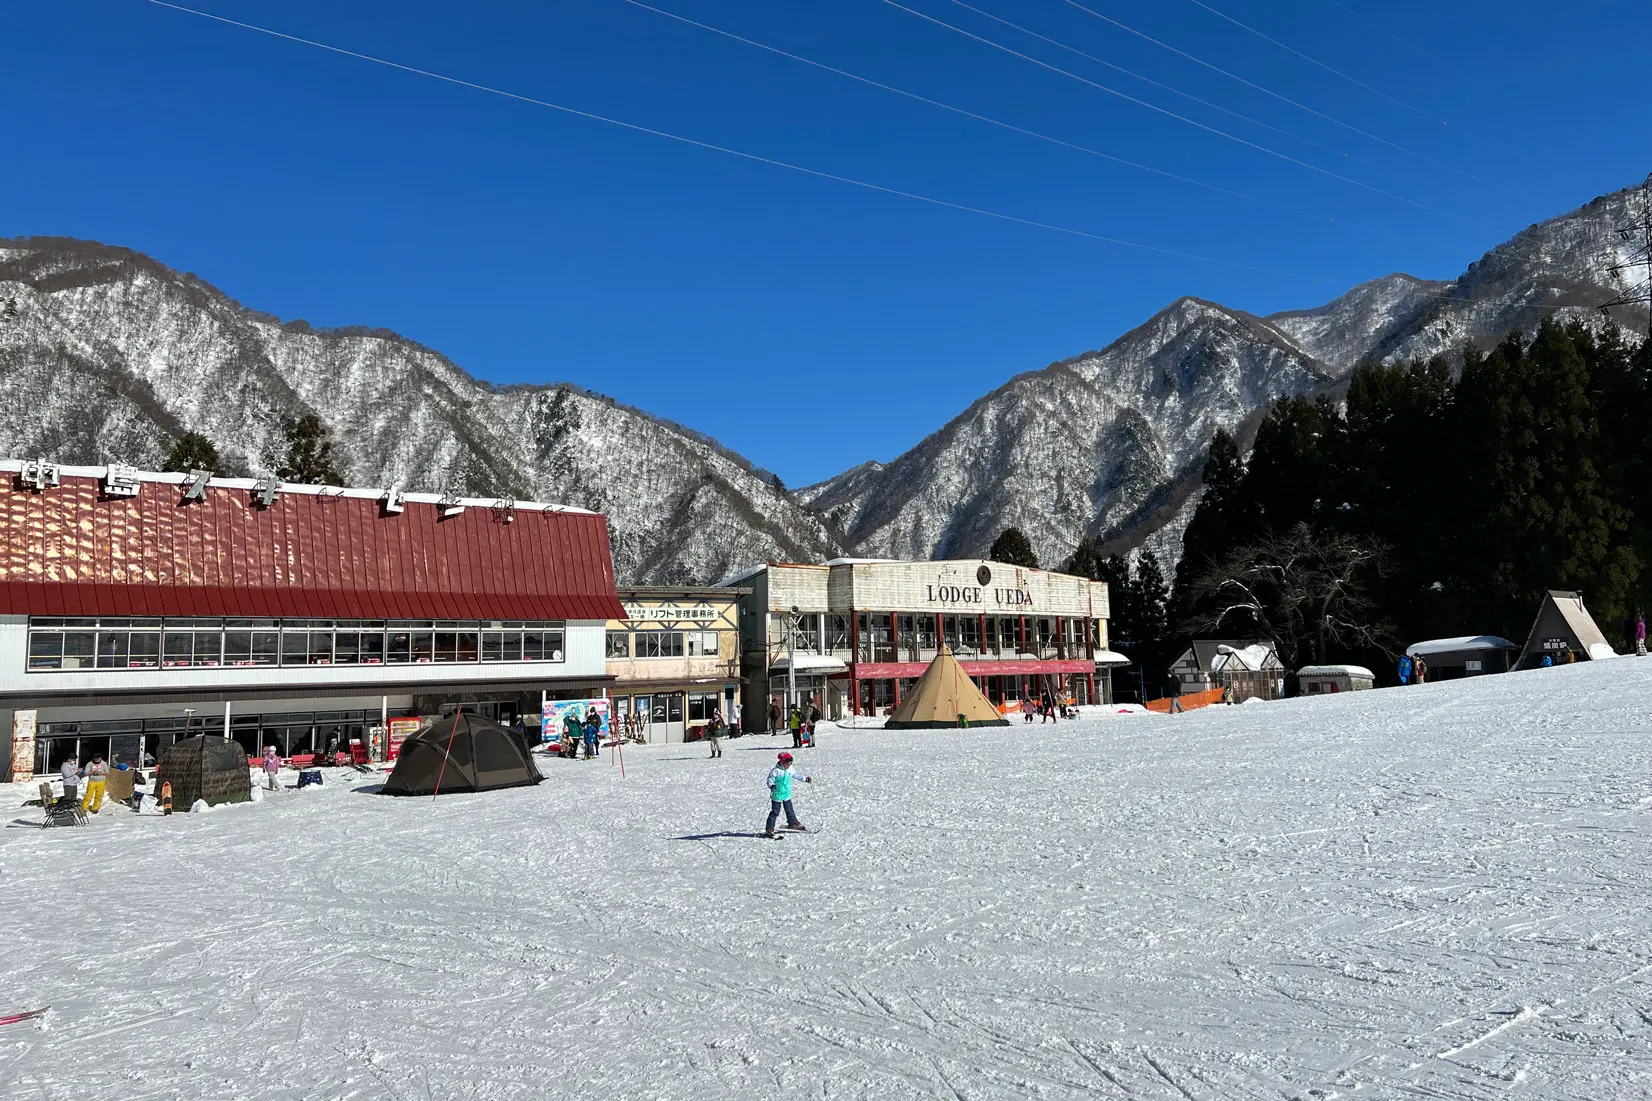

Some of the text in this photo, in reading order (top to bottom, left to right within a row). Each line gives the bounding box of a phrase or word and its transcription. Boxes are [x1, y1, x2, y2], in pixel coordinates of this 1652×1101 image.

[926, 585, 1033, 605] LODGE UEDA
[650, 609, 715, 618] リフト管理事務所
